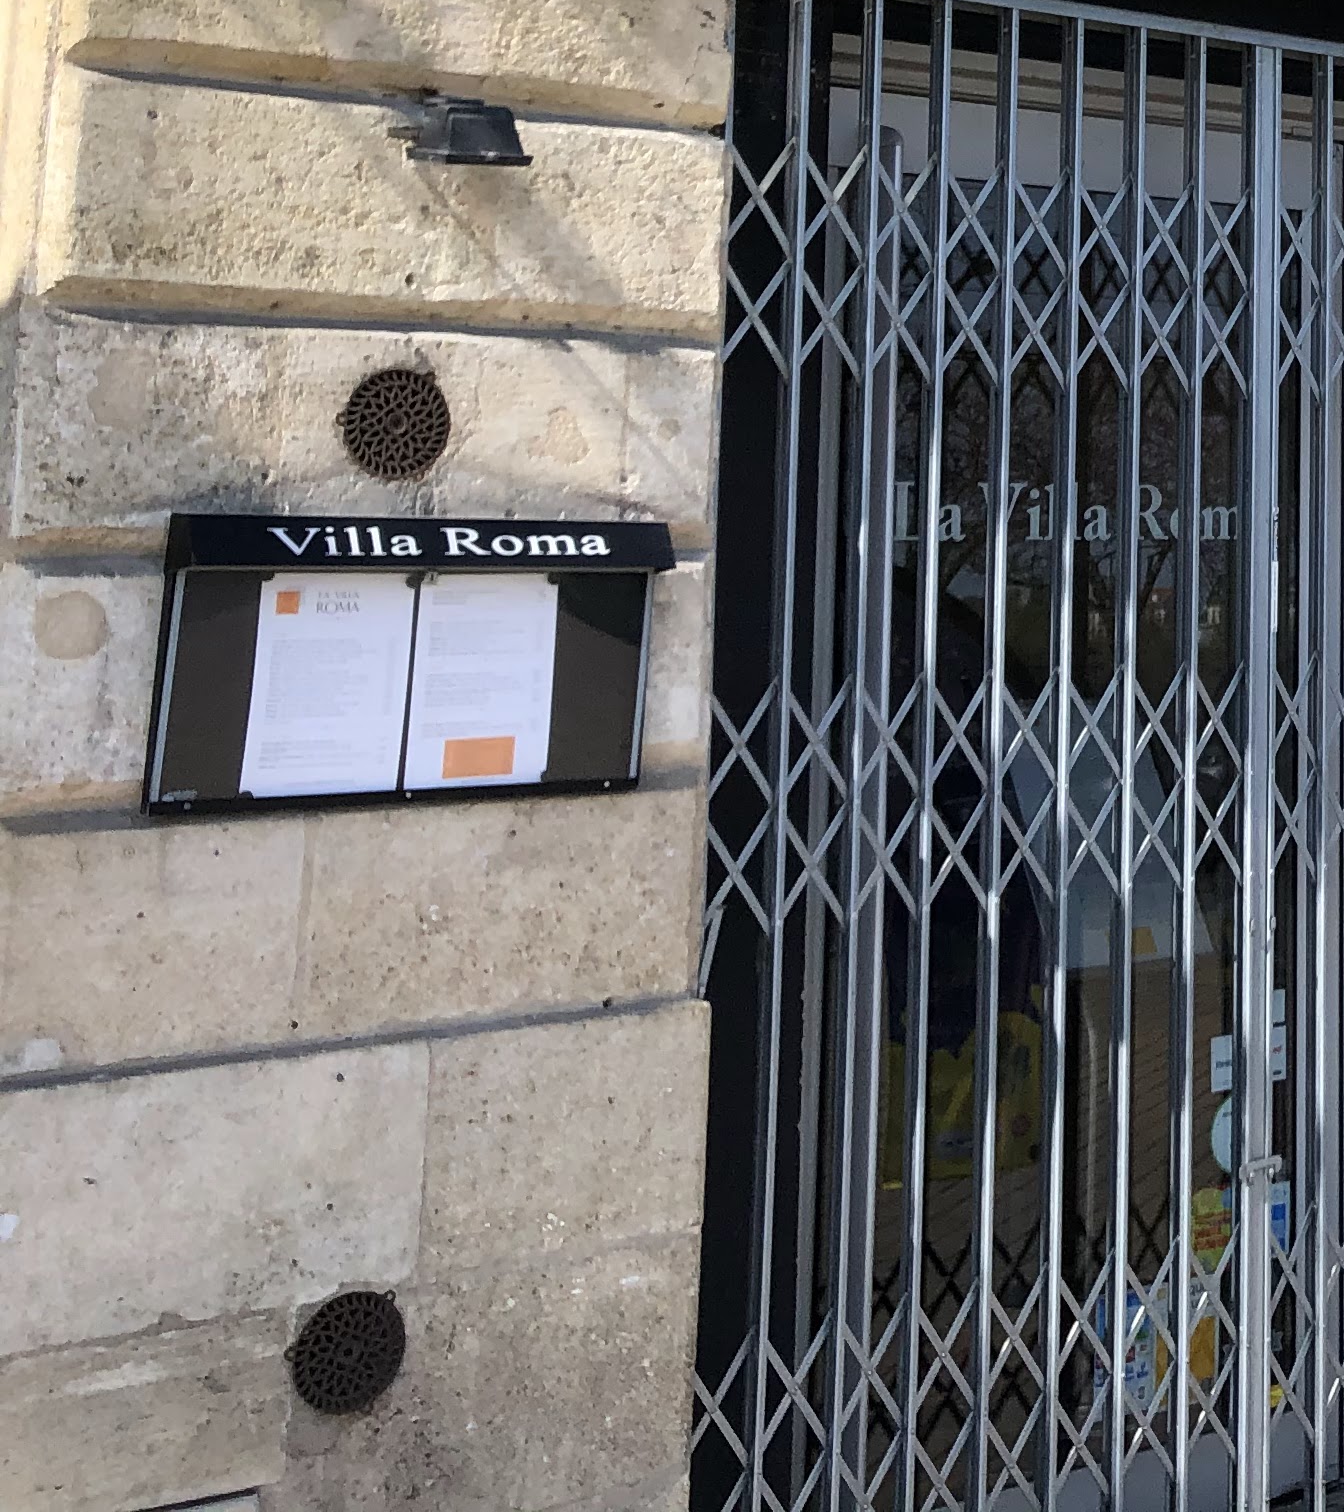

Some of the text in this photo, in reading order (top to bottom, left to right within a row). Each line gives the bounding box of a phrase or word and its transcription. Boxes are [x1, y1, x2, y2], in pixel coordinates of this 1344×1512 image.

[893, 481, 966, 542] La
[267, 527, 611, 558] Villa Roma
[316, 601, 360, 614] ROMA
